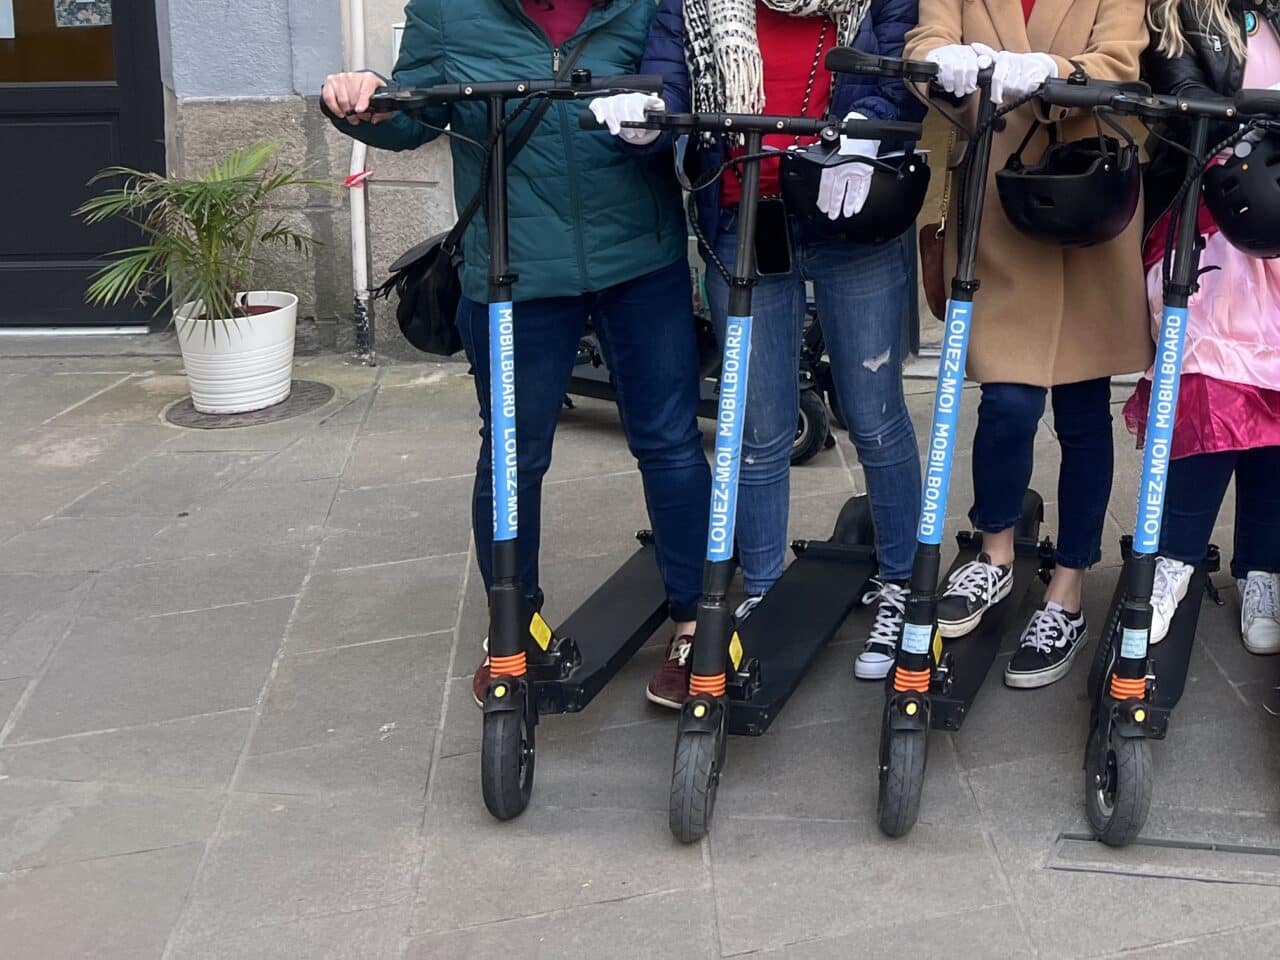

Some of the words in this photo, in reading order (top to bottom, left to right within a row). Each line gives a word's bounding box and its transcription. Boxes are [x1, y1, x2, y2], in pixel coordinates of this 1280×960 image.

[499, 308, 515, 418] MOBILBOARD
[719, 323, 743, 437] MOBILBOARD
[939, 308, 967, 414] LOUEZ-MOI
[1155, 314, 1182, 429] MOBILBOARD
[504, 427, 518, 532] LOUEZ-MOI
[709, 446, 733, 554] LOUEZ-MOI
[920, 423, 948, 537] MOBILBOARD
[1142, 437, 1169, 546] LOUEZ-MOI
